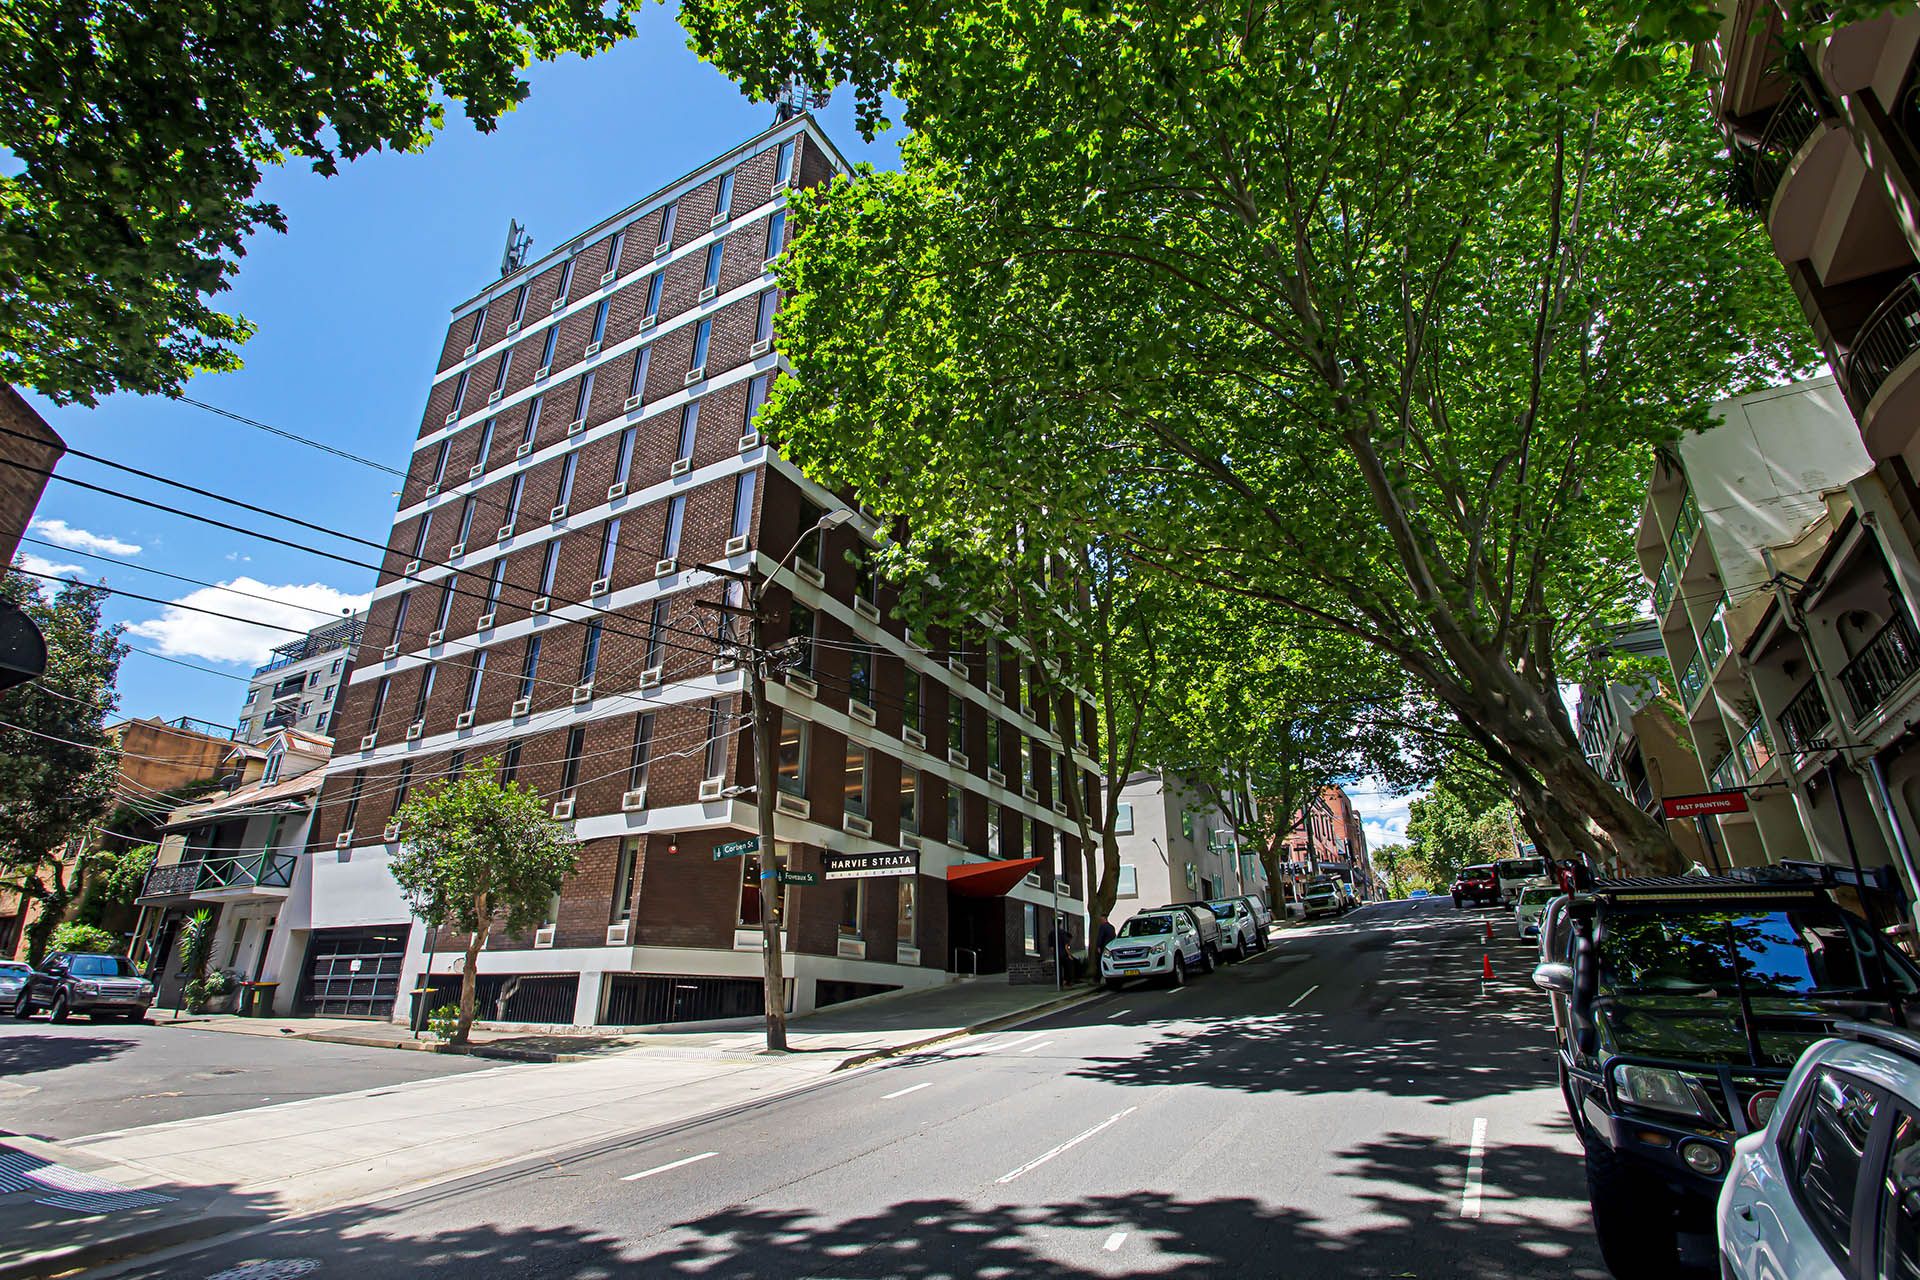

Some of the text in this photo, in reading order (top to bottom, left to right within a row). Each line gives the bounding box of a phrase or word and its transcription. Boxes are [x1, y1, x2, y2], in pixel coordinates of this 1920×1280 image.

[1695, 800, 1731, 809] PRINTING
[724, 840, 754, 854] Corben St
[831, 856, 911, 869] HARVIE STRATA
[785, 872, 814, 882] Foveaux St
